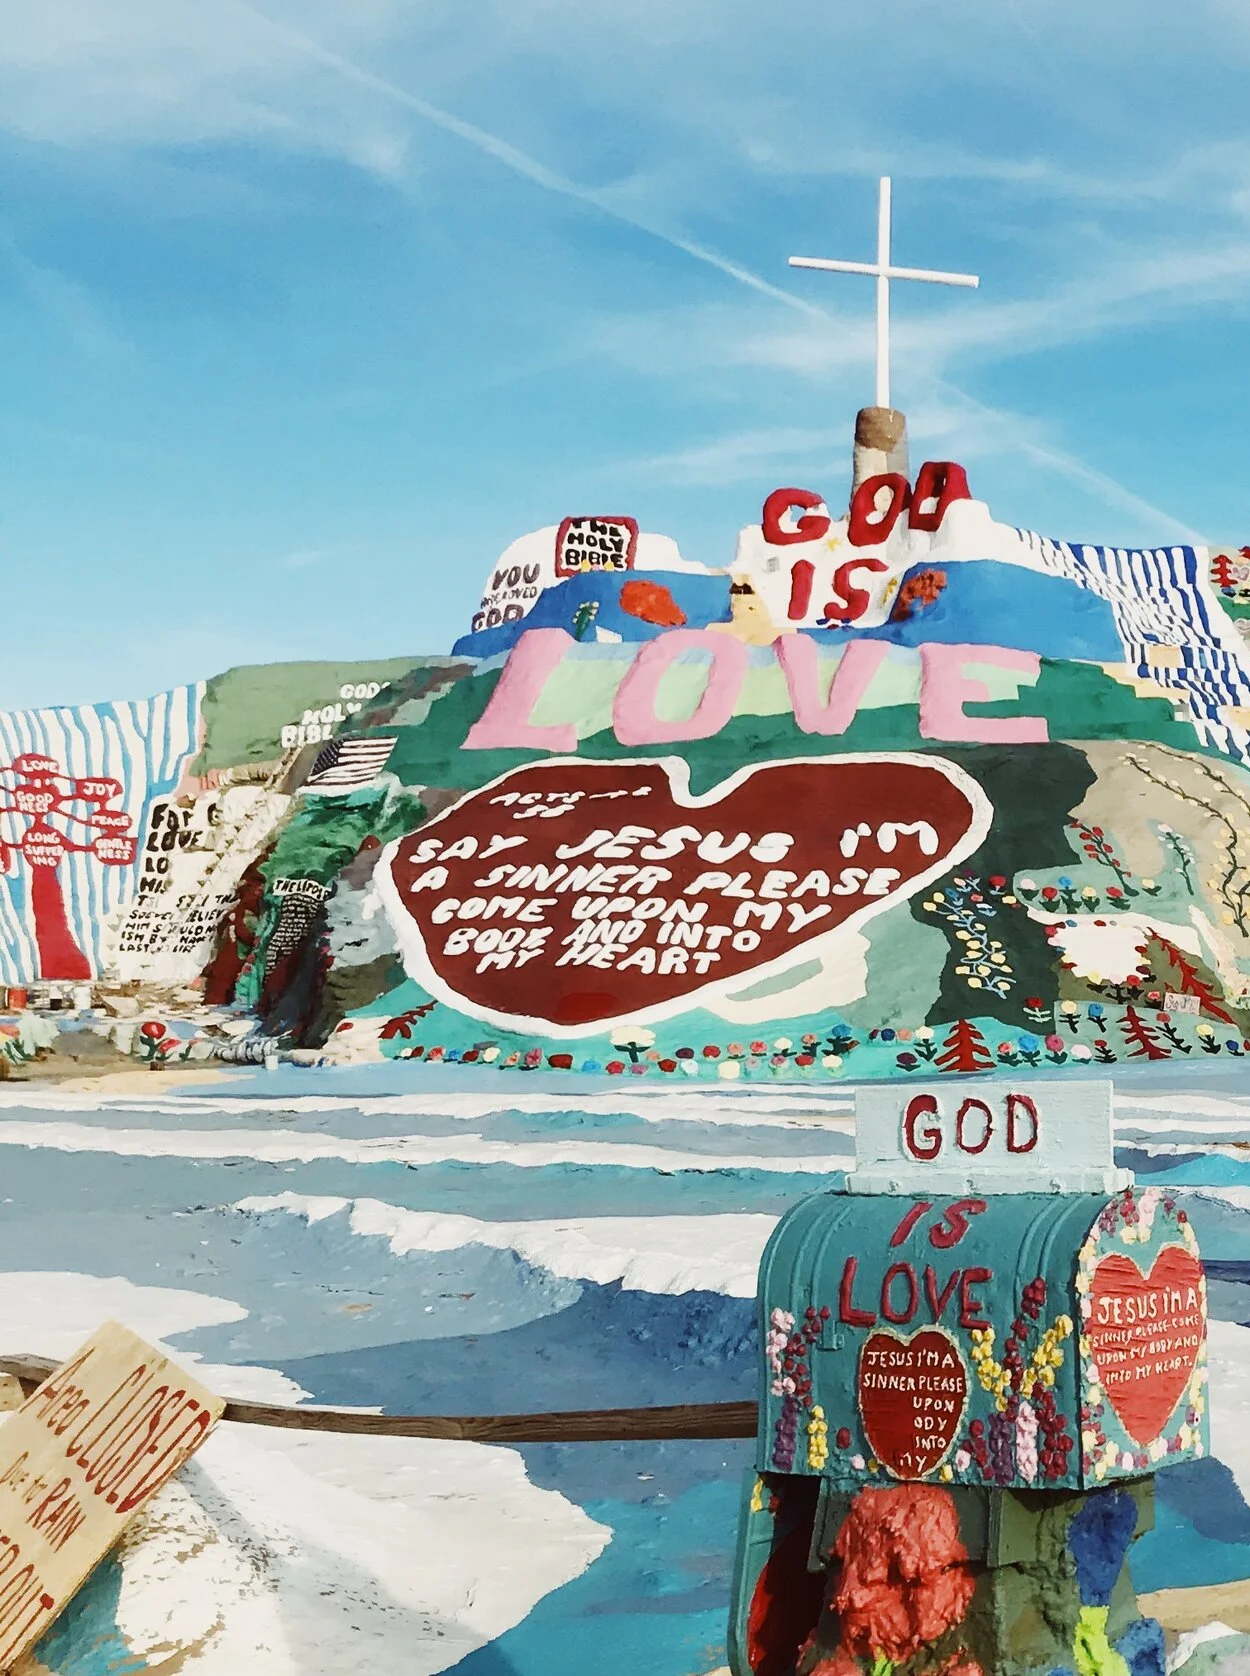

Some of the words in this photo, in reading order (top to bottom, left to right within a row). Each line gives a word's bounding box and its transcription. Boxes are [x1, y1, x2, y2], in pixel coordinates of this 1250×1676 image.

[762, 461, 973, 547] GOD
[567, 532, 624, 553] HOLY
[492, 563, 540, 590] YOU
[787, 558, 889, 621] IS
[460, 628, 1050, 752] LOVE
[21, 760, 58, 773] LOVE
[16, 790, 54, 804] GOOD
[83, 782, 117, 798] JOY
[489, 791, 587, 807] ACTS
[91, 815, 129, 827] PEACE
[27, 832, 61, 844] LONG
[409, 834, 529, 864] SAY
[555, 825, 795, 864] JESUS
[839, 820, 940, 858] I'M
[33, 856, 58, 867] ING
[97, 849, 131, 860] NESS
[410, 865, 450, 893] A
[474, 862, 673, 895] SINNER
[683, 867, 901, 899] PLEASE
[431, 895, 559, 924] COME
[571, 896, 709, 923] UPON
[733, 900, 832, 933] MY
[443, 926, 554, 955] BODY
[561, 919, 647, 946] AND
[656, 920, 761, 952] INTO
[476, 948, 545, 974] MY
[555, 943, 721, 975] HEART
[904, 1093, 1040, 1161] GOD
[889, 1199, 988, 1250] IS
[838, 1256, 994, 1330] LOVE
[1097, 1292, 1158, 1325] JESUS
[1186, 1286, 1198, 1311] A
[1092, 1329, 1133, 1348] SINNER
[1136, 1319, 1169, 1337] PLEASE
[1172, 1313, 1199, 1329] COME
[867, 1351, 914, 1368] JESUS
[917, 1348, 939, 1368] I'M
[941, 1353, 955, 1369] A
[1096, 1350, 1127, 1366] UPON
[1130, 1344, 1147, 1359] MY
[1149, 1338, 1172, 1354] BODY
[1174, 1334, 1199, 1350] AND
[863, 1372, 916, 1391] SINNER
[918, 1375, 963, 1393] PLEASE
[1105, 1369, 1132, 1386] INTO
[1135, 1364, 1152, 1380] MY
[913, 1396, 955, 1413] UPON
[65, 1363, 212, 1515] CLOSED
[915, 1435, 947, 1451] INTO
[26, 1477, 87, 1554] RAIN
